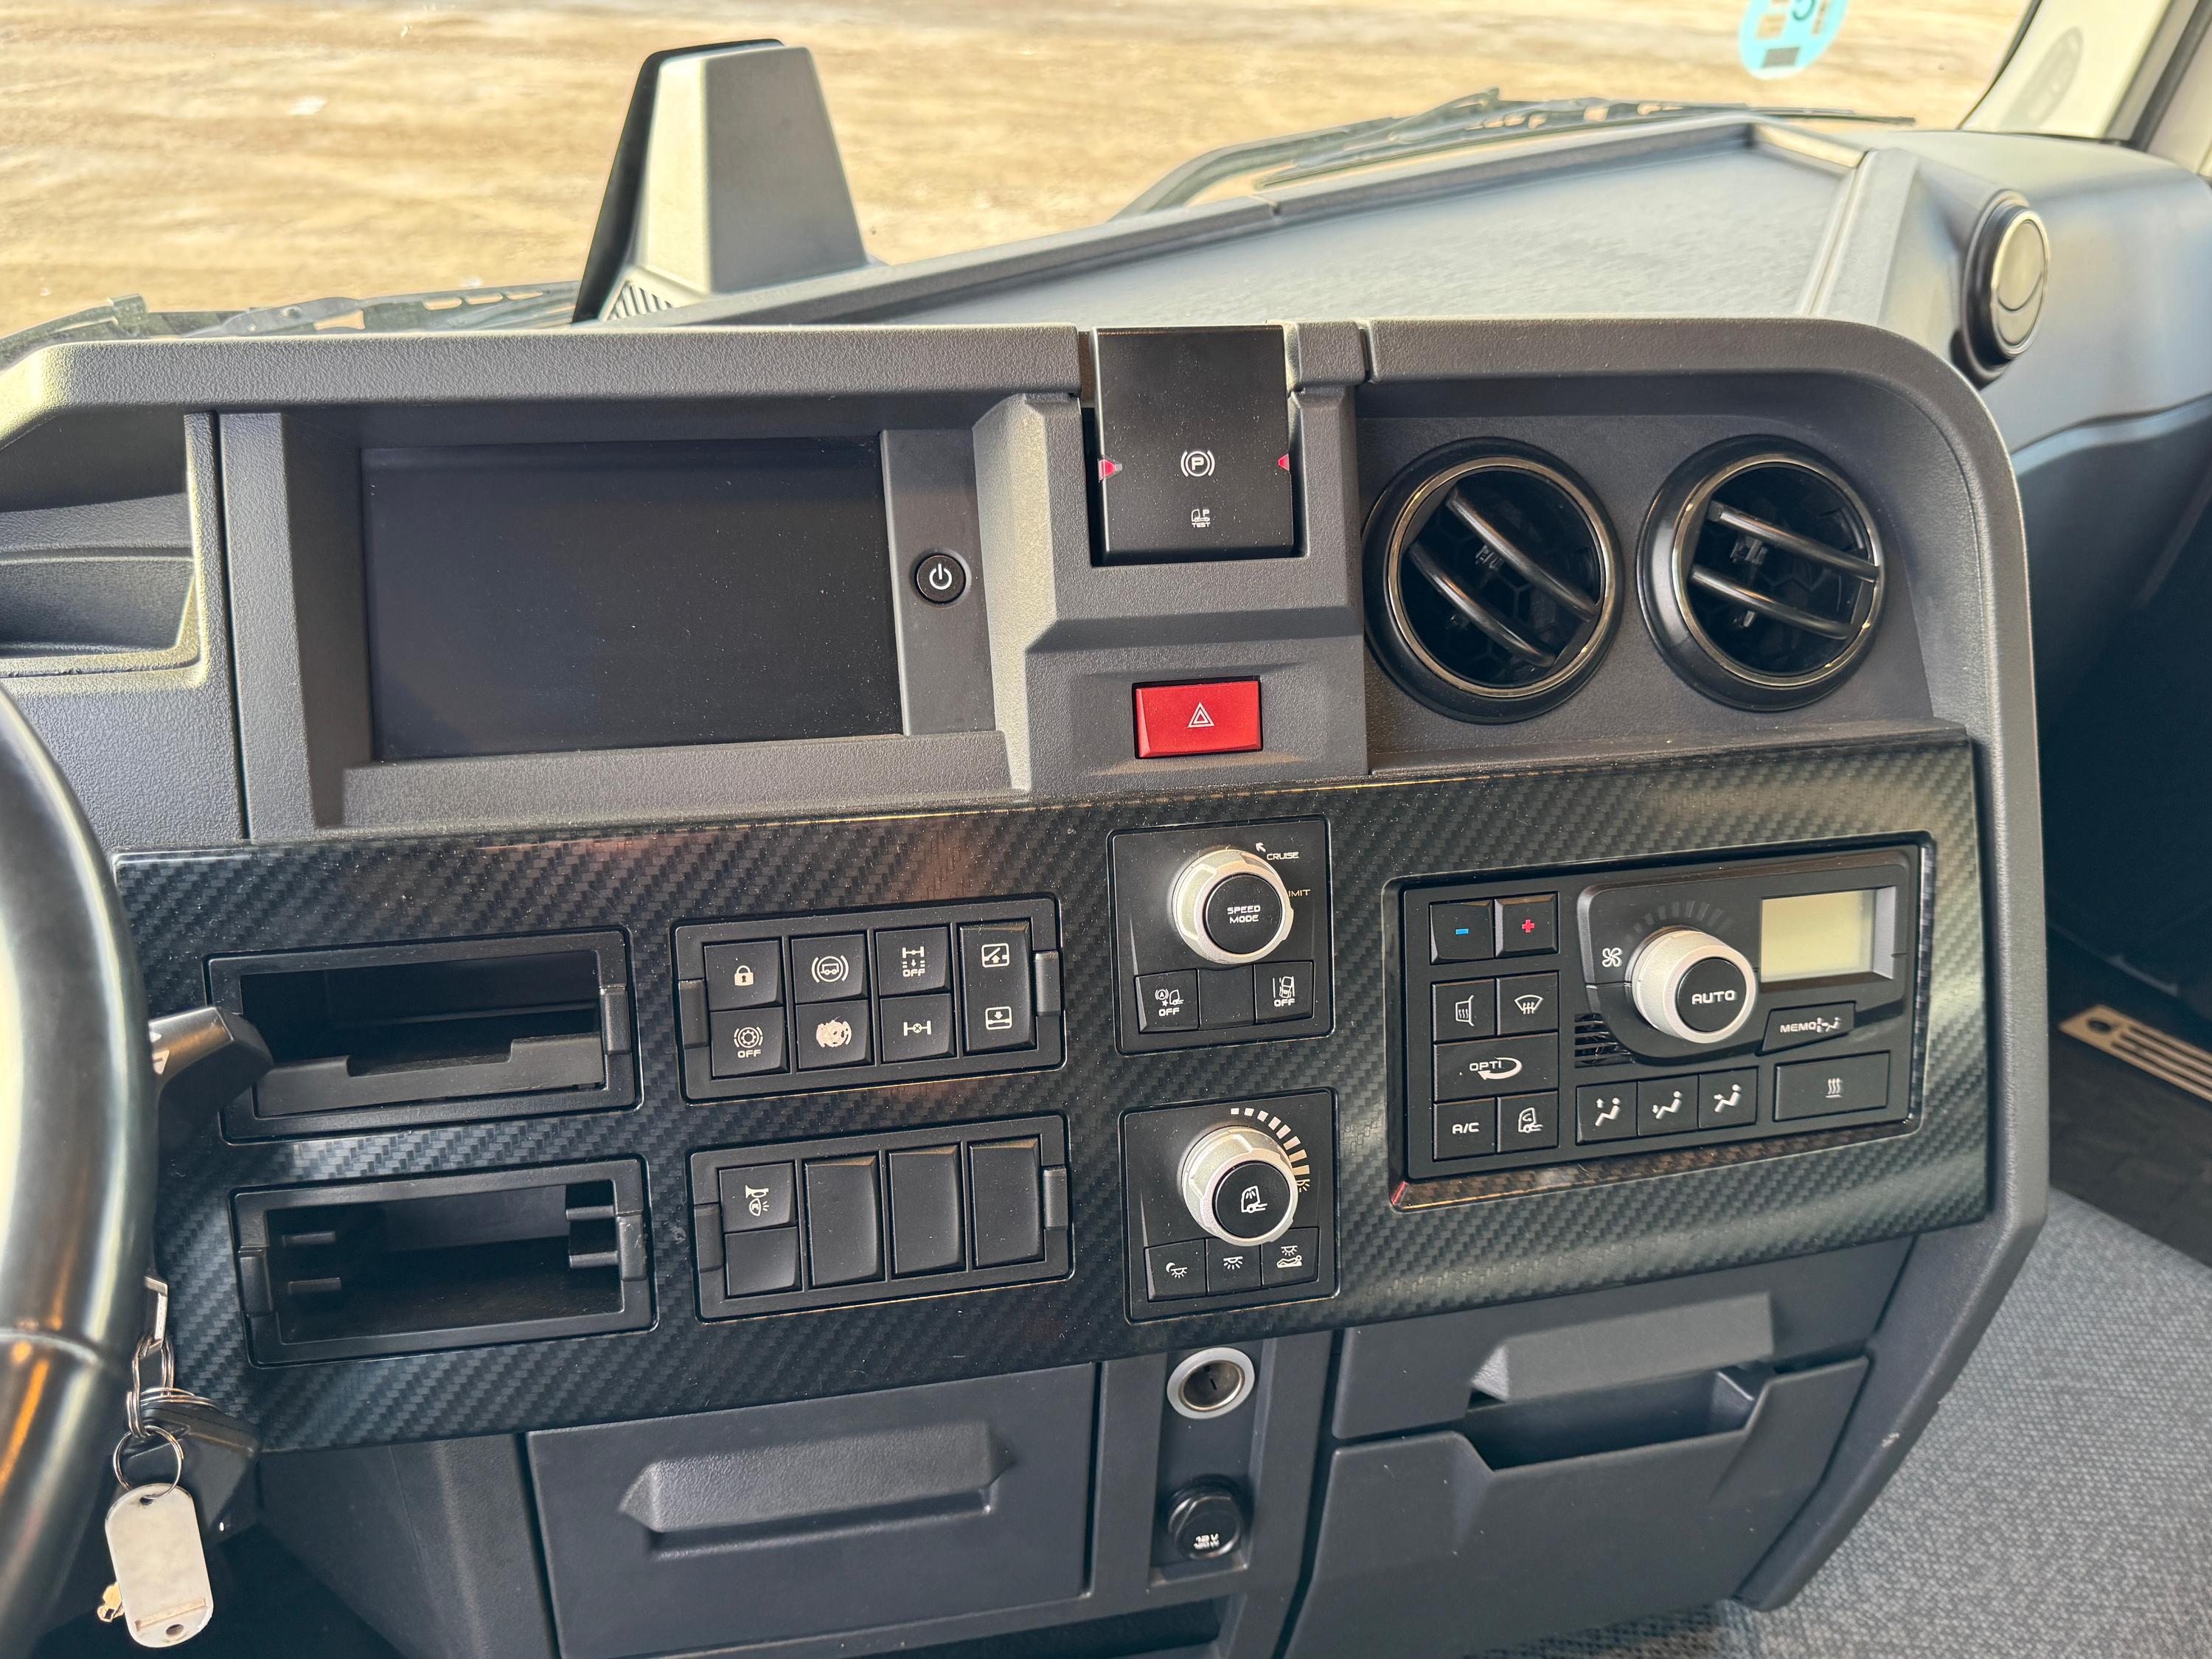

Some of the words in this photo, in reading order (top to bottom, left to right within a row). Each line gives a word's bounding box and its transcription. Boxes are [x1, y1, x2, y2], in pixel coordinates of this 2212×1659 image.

[1266, 852, 1300, 860] CRUISE
[1287, 889, 1311, 897] IMIT
[1227, 905, 1261, 915] SPEED
[1229, 914, 1259, 924] MODE
[902, 968, 926, 978] OFF
[1274, 998, 1295, 1007] OFF
[1691, 990, 1736, 1005] AUTO
[1158, 1007, 1180, 1017] OFF
[1780, 1021, 1817, 1033] MEMO
[737, 1048, 762, 1059] OFF
[1470, 1060, 1502, 1071] OPTI
[1452, 1121, 1480, 1134] A/C
